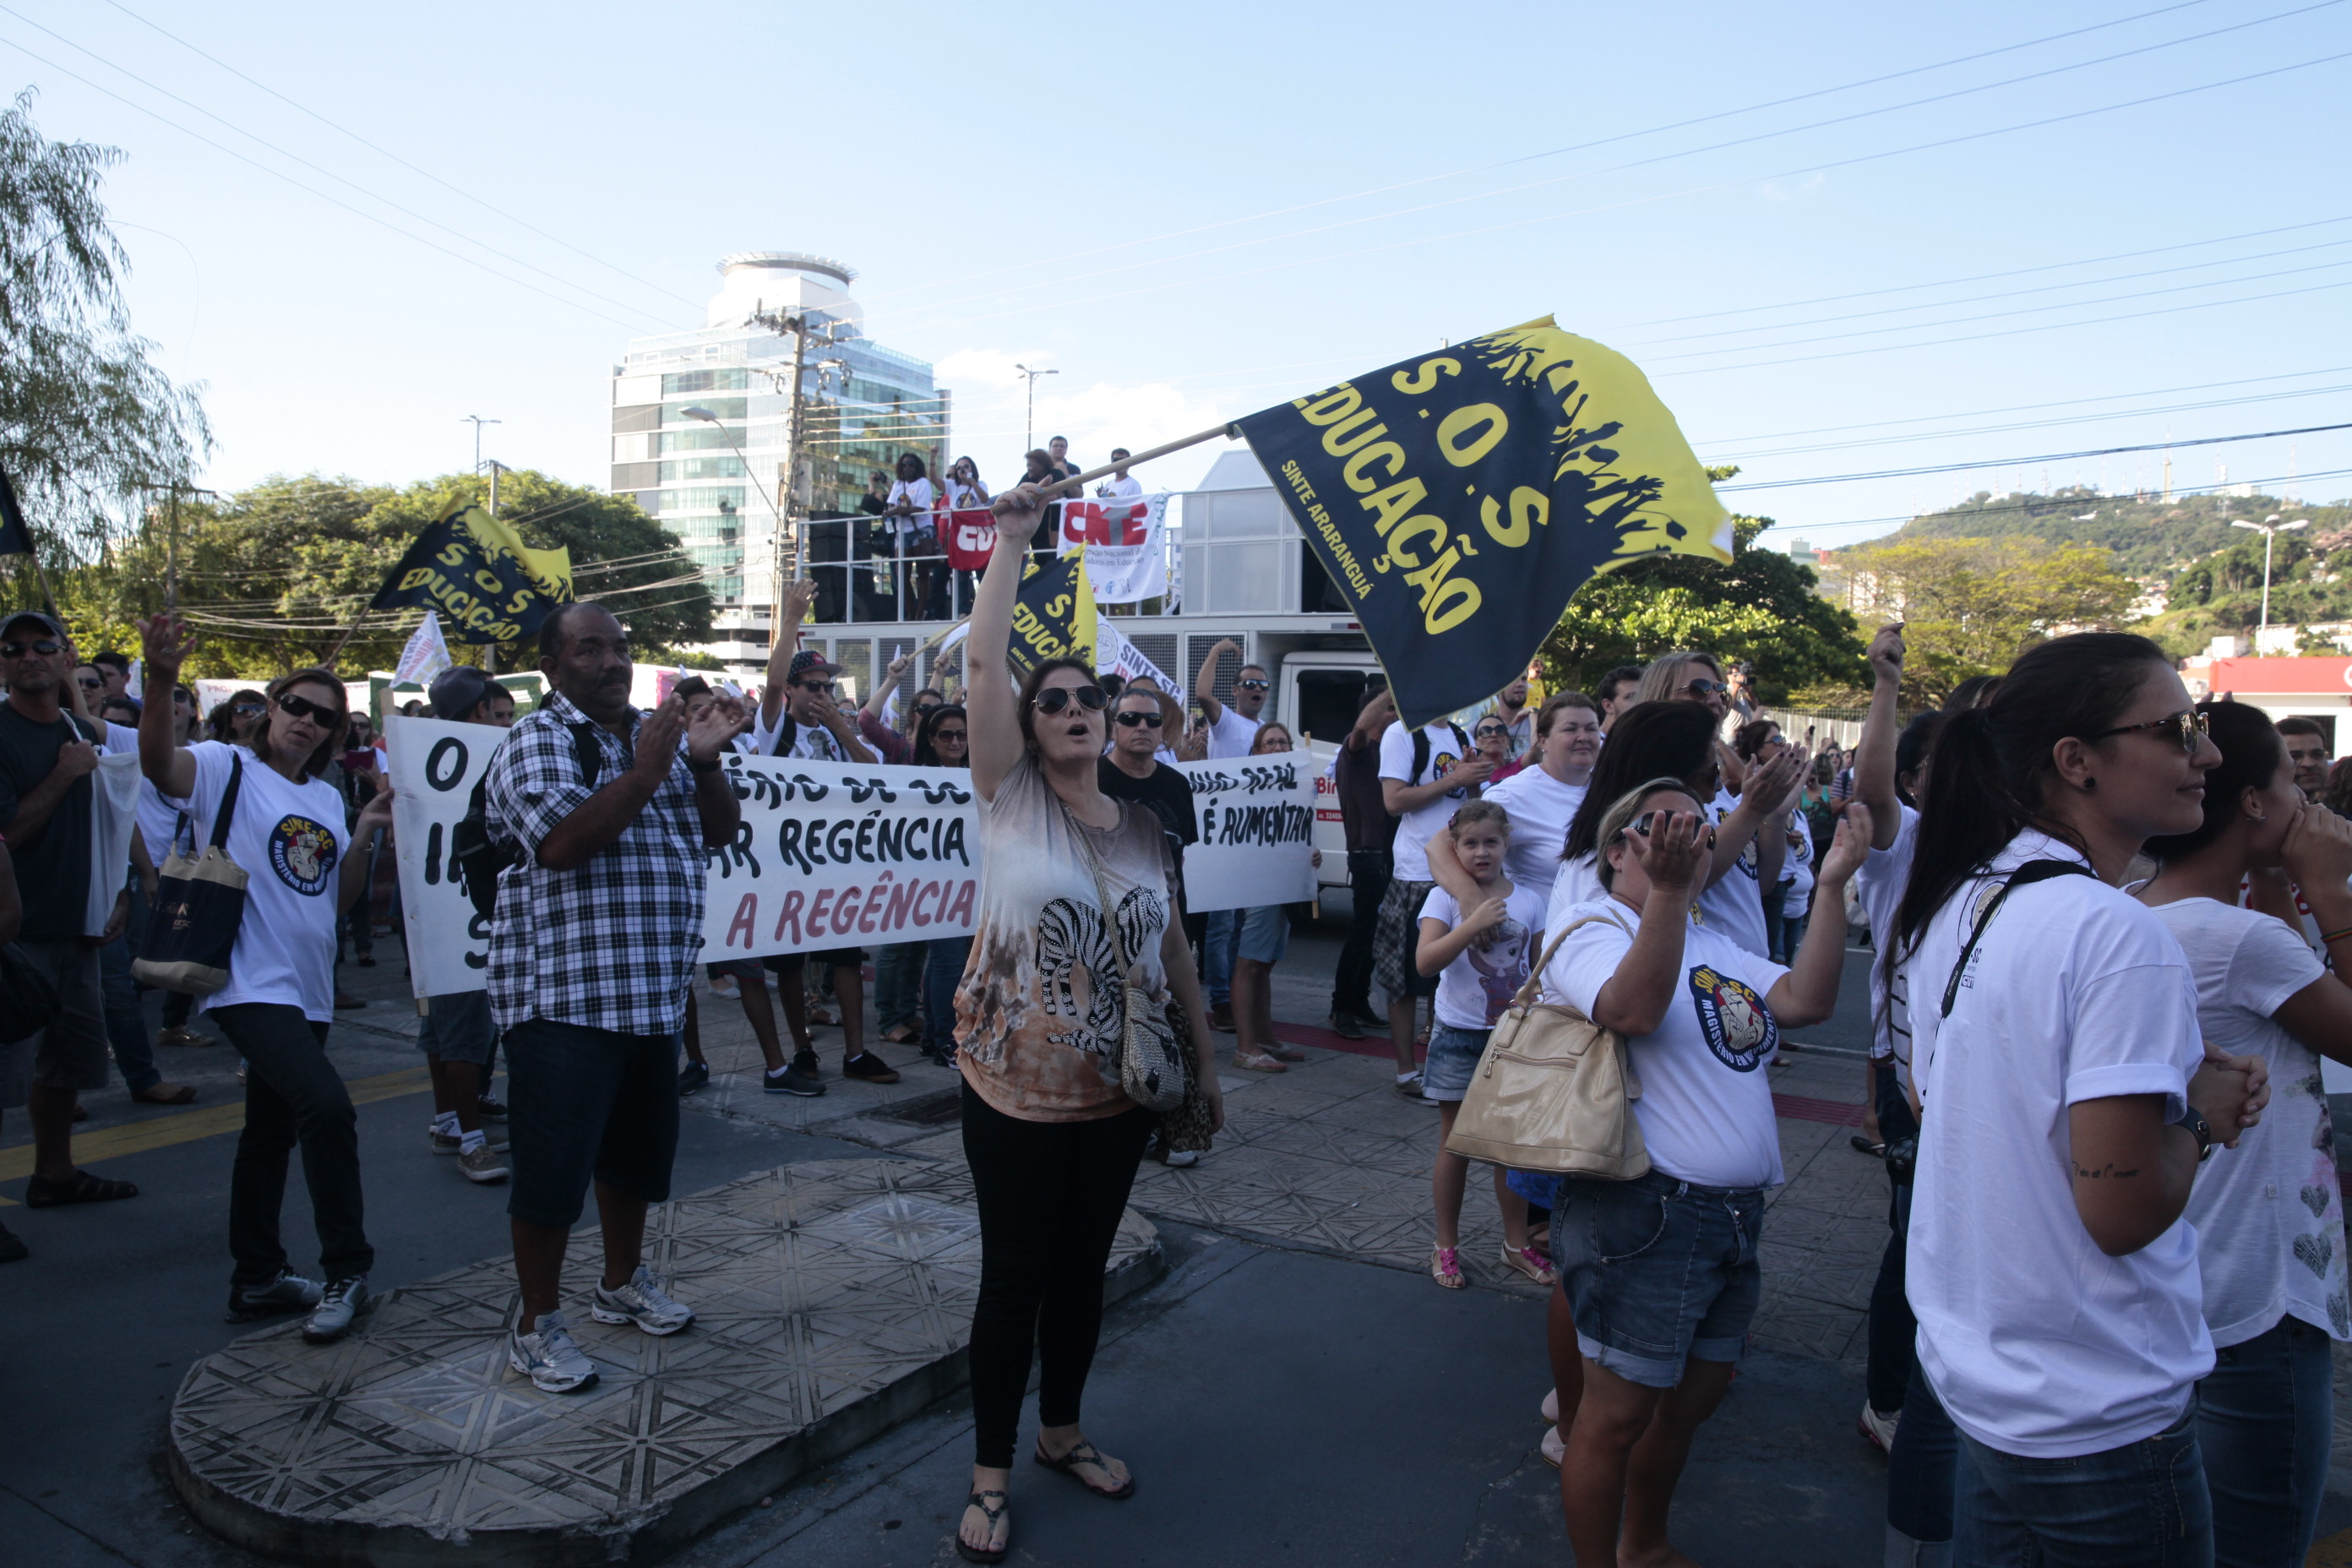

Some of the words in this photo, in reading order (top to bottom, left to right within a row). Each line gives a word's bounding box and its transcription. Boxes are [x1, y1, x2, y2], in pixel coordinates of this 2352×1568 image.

[956, 524, 997, 552] CU
[1064, 502, 1148, 547] CNTE
[1281, 459, 1316, 506] SINTE
[1306, 502, 1376, 601] ARARANGUÁ
[426, 737, 468, 792] O
[779, 809, 970, 875] REGÊNCIA
[1203, 797, 1218, 845] É
[1219, 799, 1314, 847] AUMENTAR
[726, 892, 758, 950] A
[774, 869, 977, 945] REGÊNCIA
[1701, 999, 1734, 1064] MAGISTÉRIO
